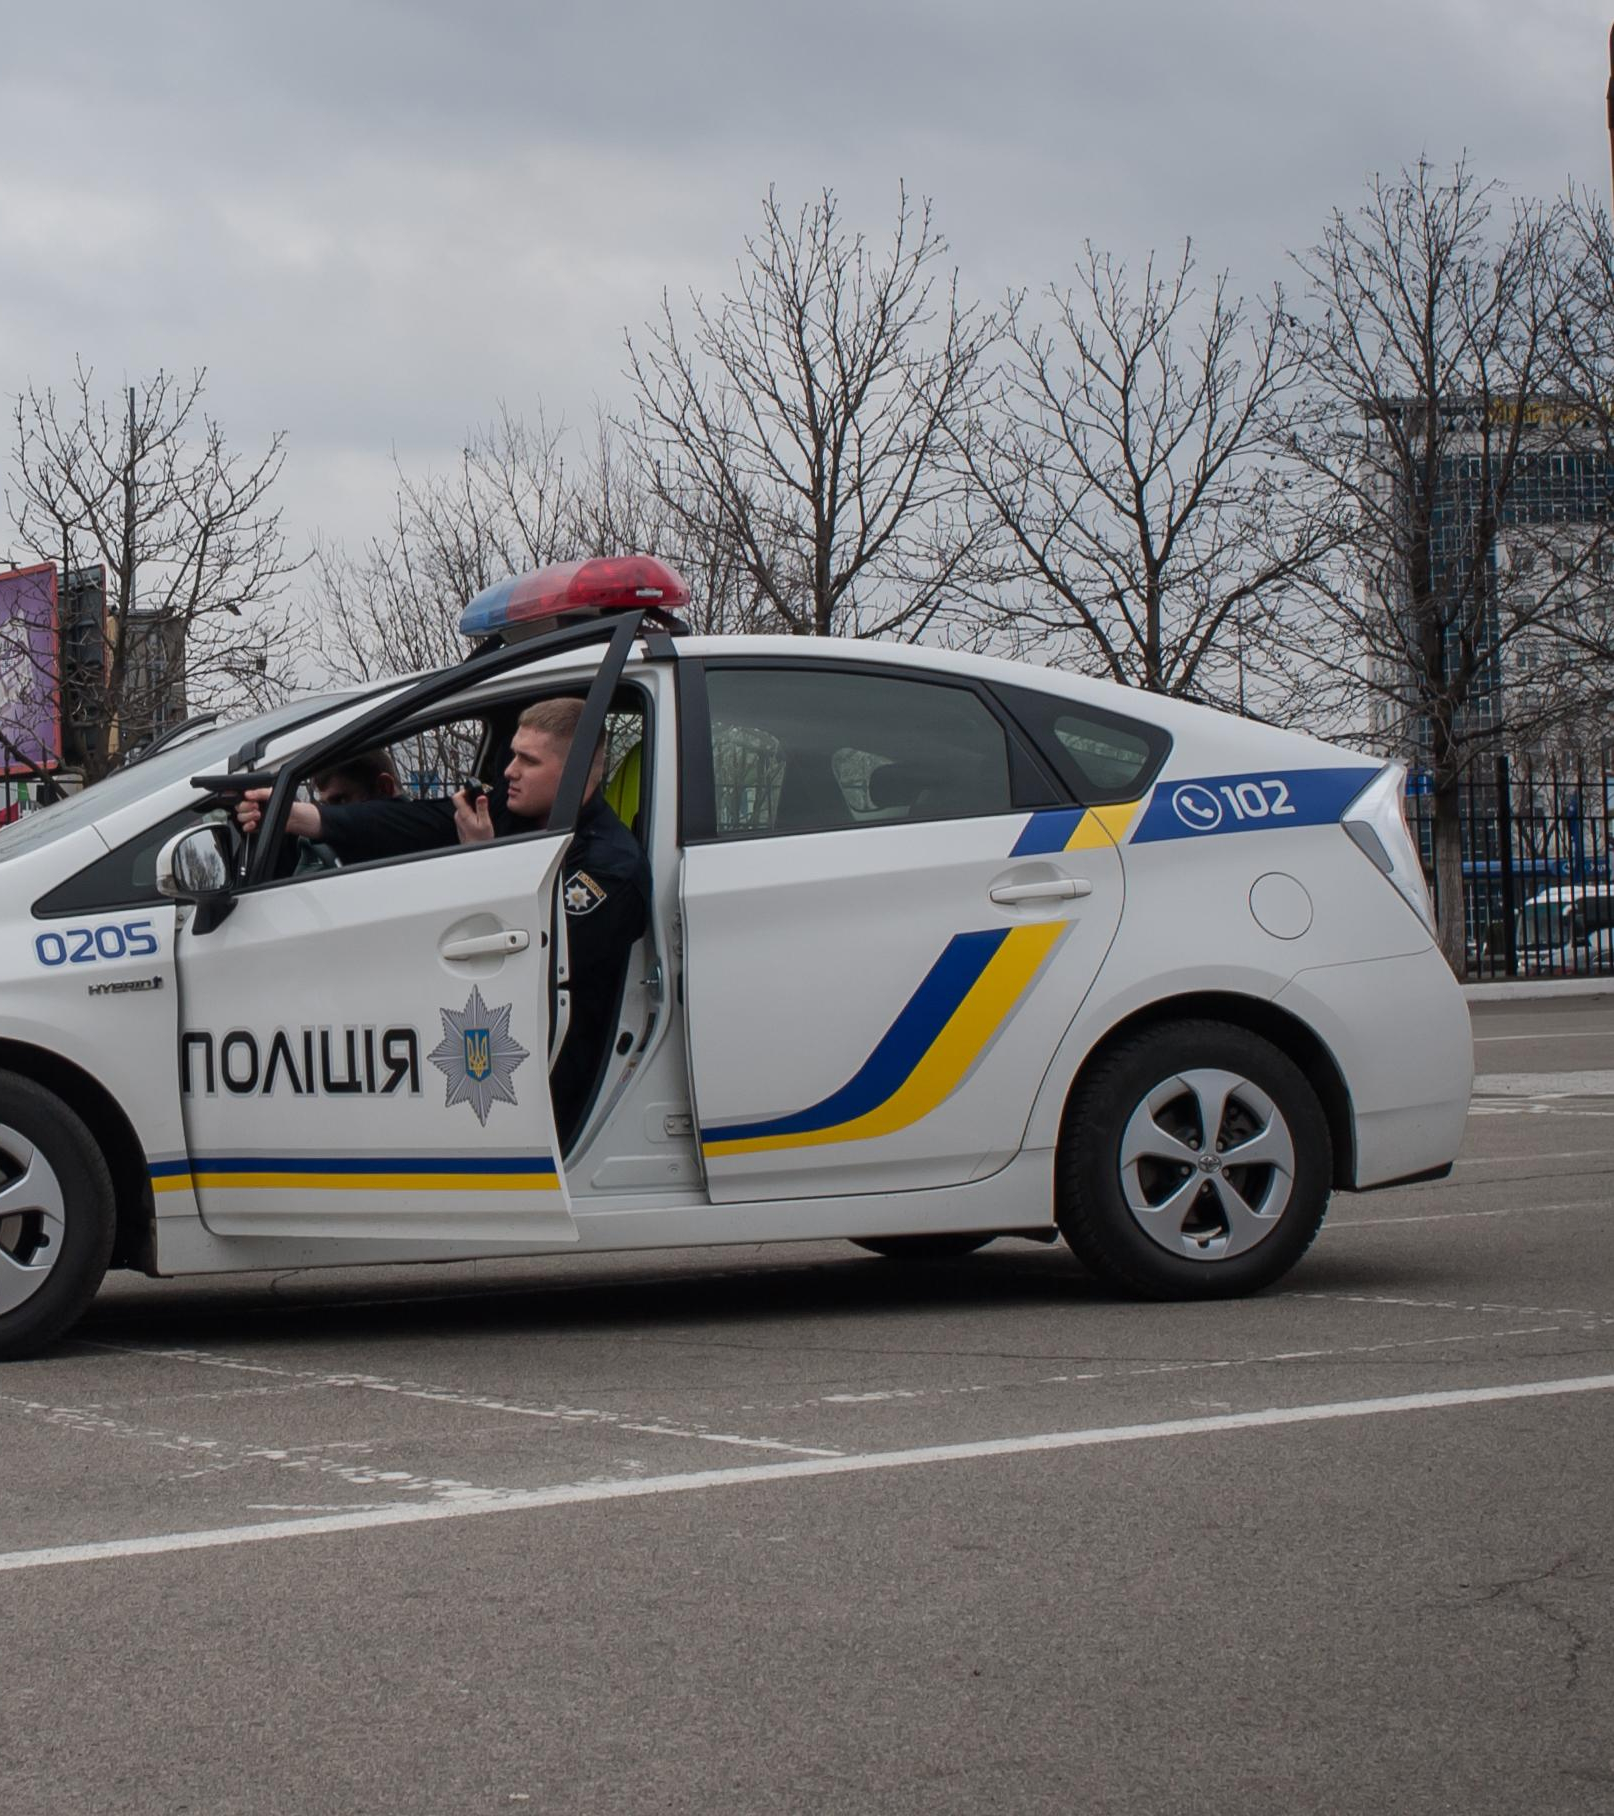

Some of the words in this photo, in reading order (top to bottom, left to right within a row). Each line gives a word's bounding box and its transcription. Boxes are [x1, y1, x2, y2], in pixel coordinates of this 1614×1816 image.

[1220, 780, 1296, 819] 102
[35, 921, 158, 966] 0205
[182, 1027, 420, 1094] ПОЛІЦІЯ
